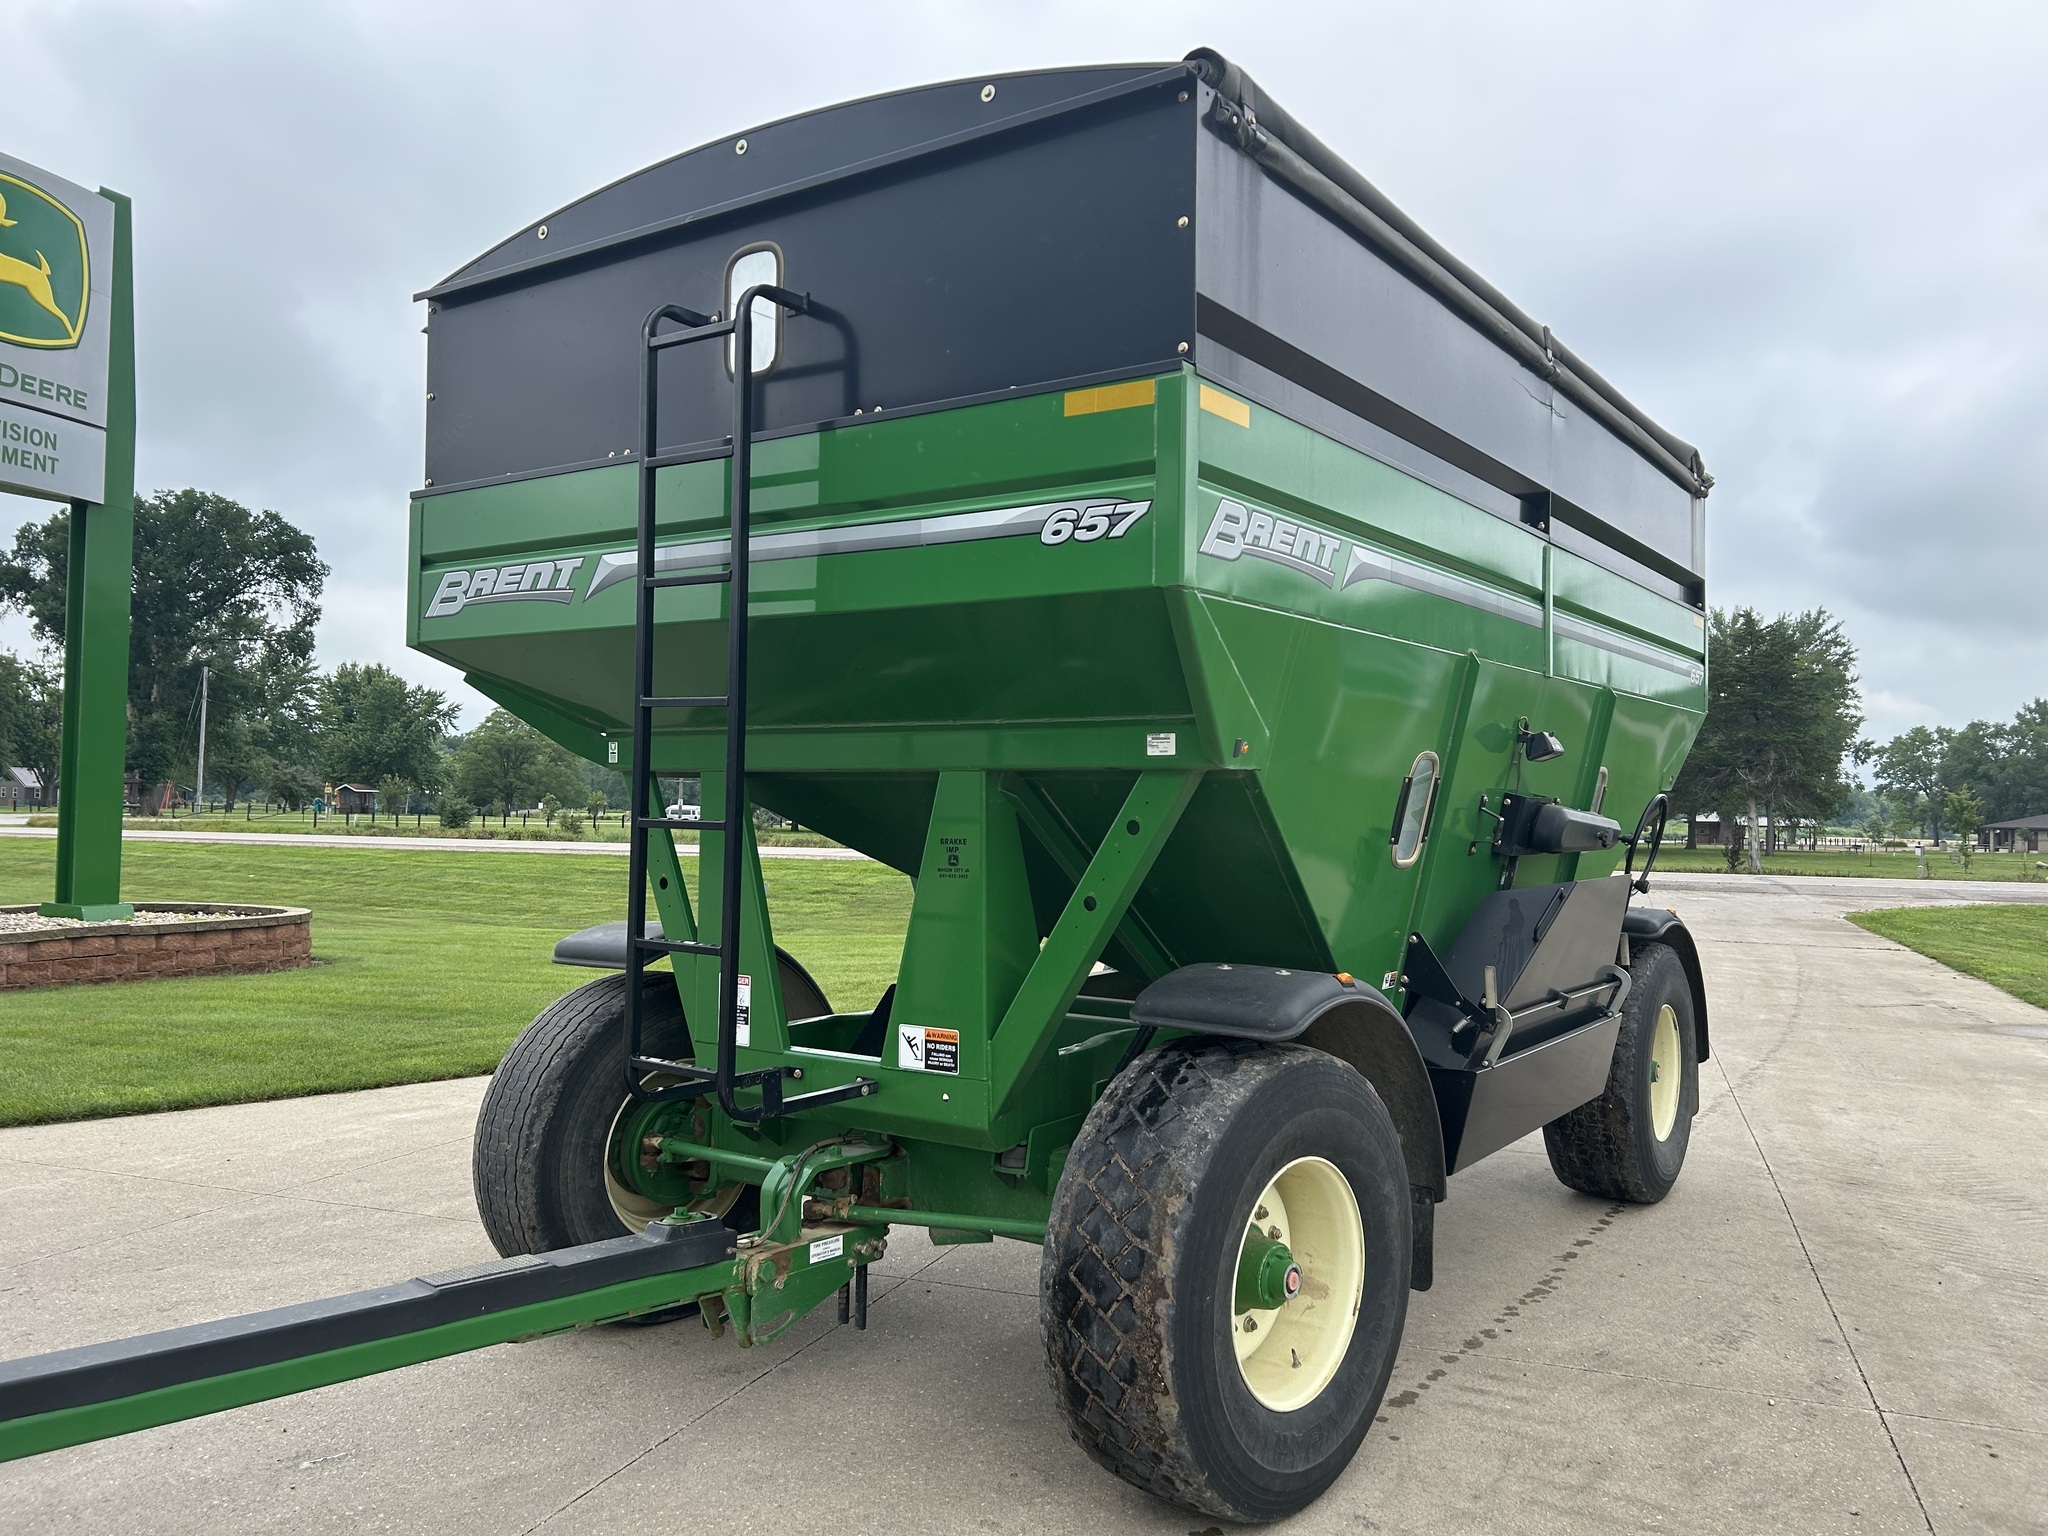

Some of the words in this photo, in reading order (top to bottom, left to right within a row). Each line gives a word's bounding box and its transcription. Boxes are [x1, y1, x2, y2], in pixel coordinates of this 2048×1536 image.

[0, 362, 88, 411] DEERE
[0, 419, 57, 451] ISION
[0, 445, 59, 475] MENT
[1040, 499, 1154, 546] 657
[1198, 497, 1342, 572] BRENT
[424, 556, 586, 619] BRENT
[1690, 668, 1704, 687] 657
[738, 977, 749, 985] GER
[932, 1032, 957, 1041] WARNING
[936, 1043, 956, 1052] RIDERS
